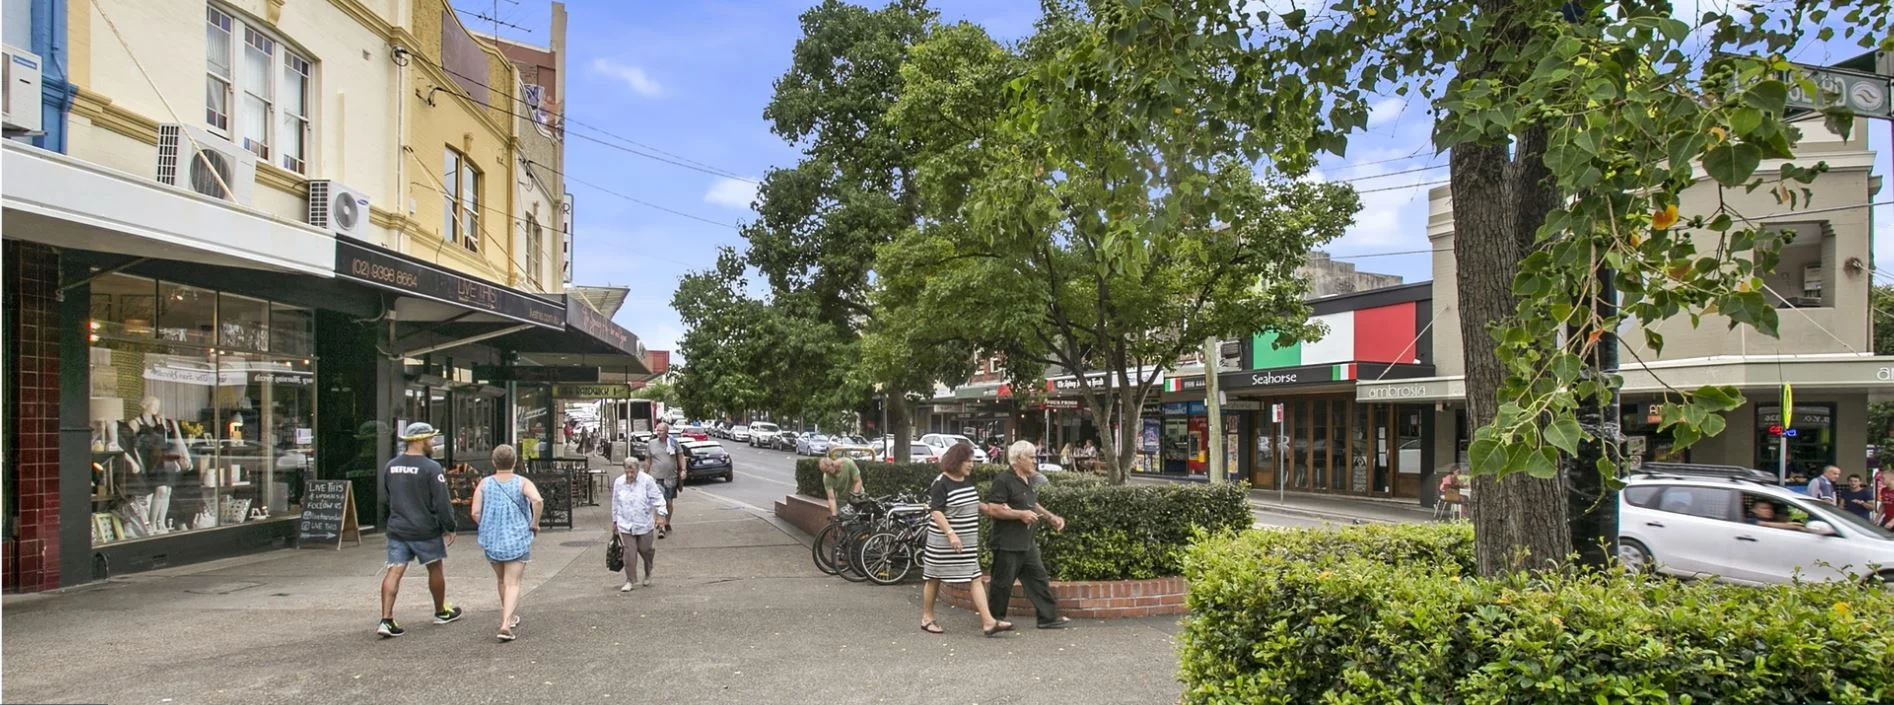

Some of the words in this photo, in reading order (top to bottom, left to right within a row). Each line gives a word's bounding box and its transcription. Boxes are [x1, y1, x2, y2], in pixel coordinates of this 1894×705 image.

[352, 258, 370, 277] (02)
[371, 264, 395, 282] 9398
[457, 279, 477, 298] LIVE
[1252, 373, 1297, 386] Seahorse
[1368, 383, 1426, 398] ambrosia
[309, 483, 327, 492] LIVE
[327, 482, 344, 493] THIS
